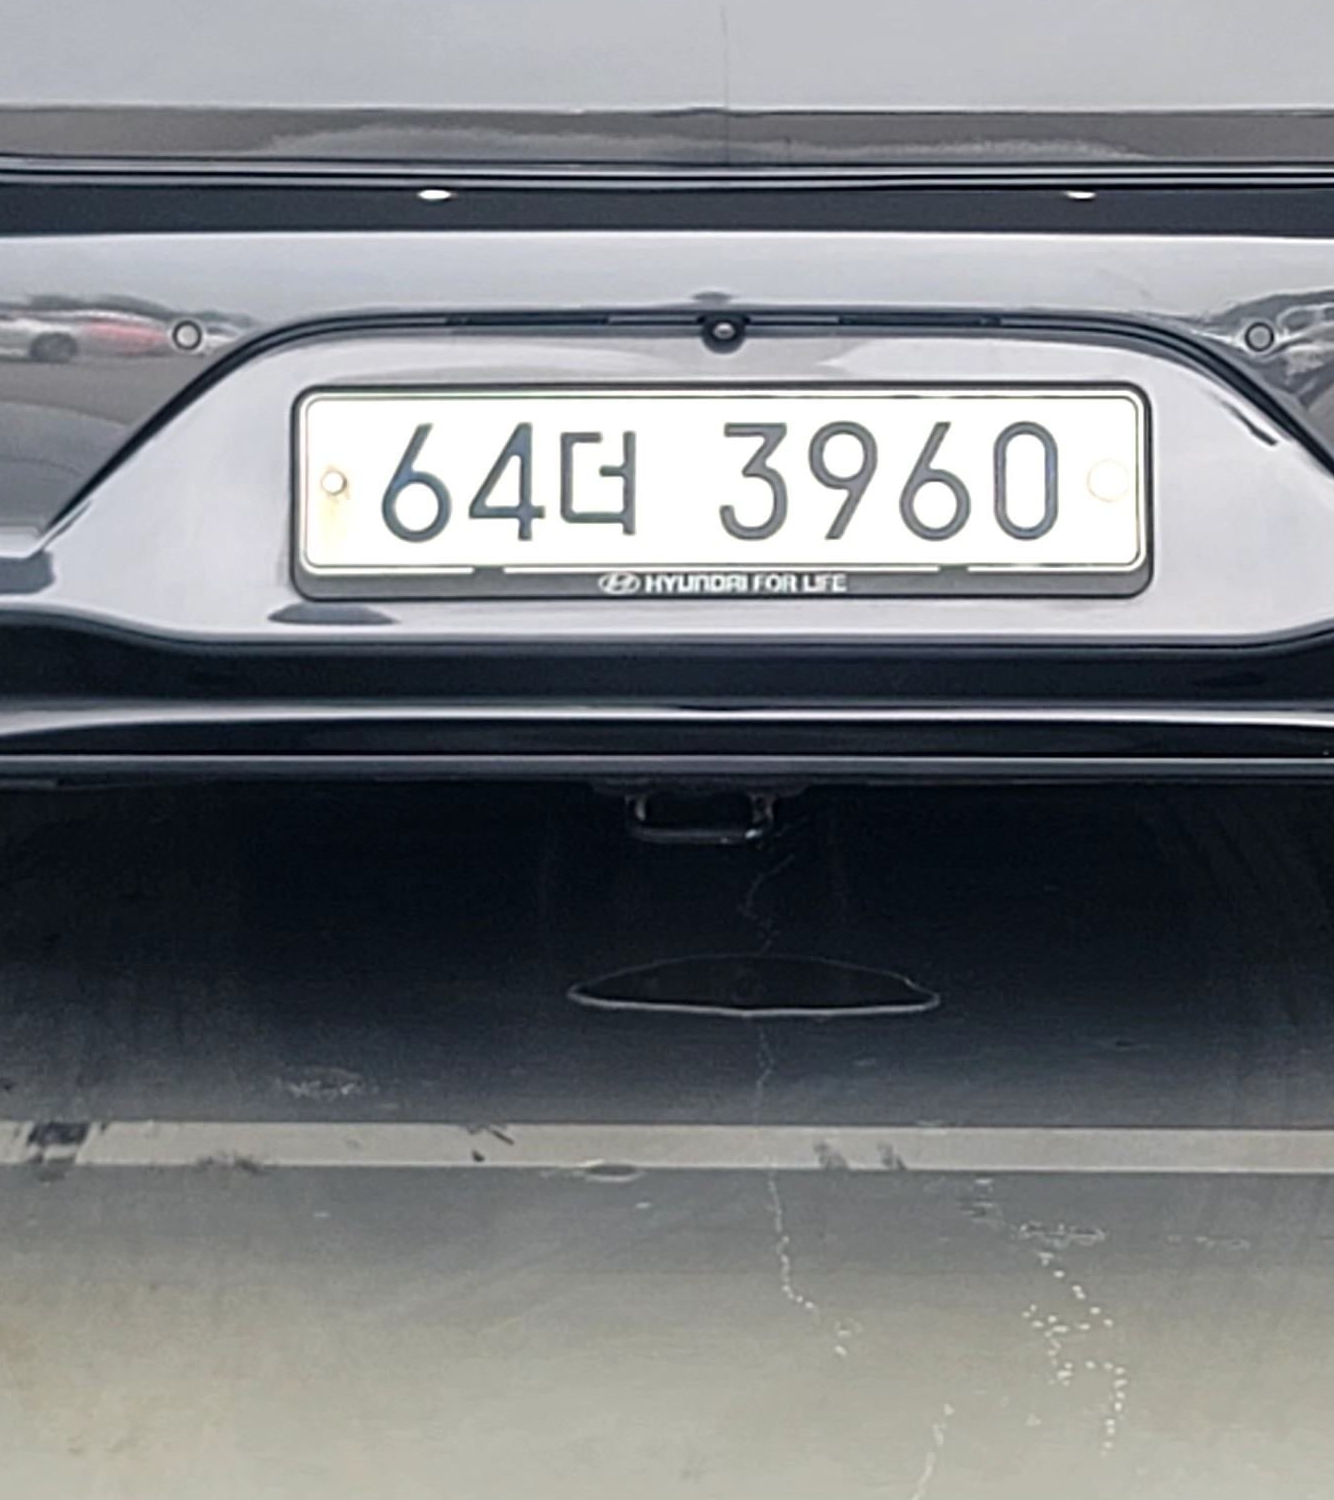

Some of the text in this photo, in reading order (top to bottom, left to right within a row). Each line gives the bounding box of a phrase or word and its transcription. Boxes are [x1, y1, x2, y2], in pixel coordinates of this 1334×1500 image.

[381, 421, 1059, 543] 64더 3960
[644, 573, 848, 593] HYUNDAI FOR LIFE
